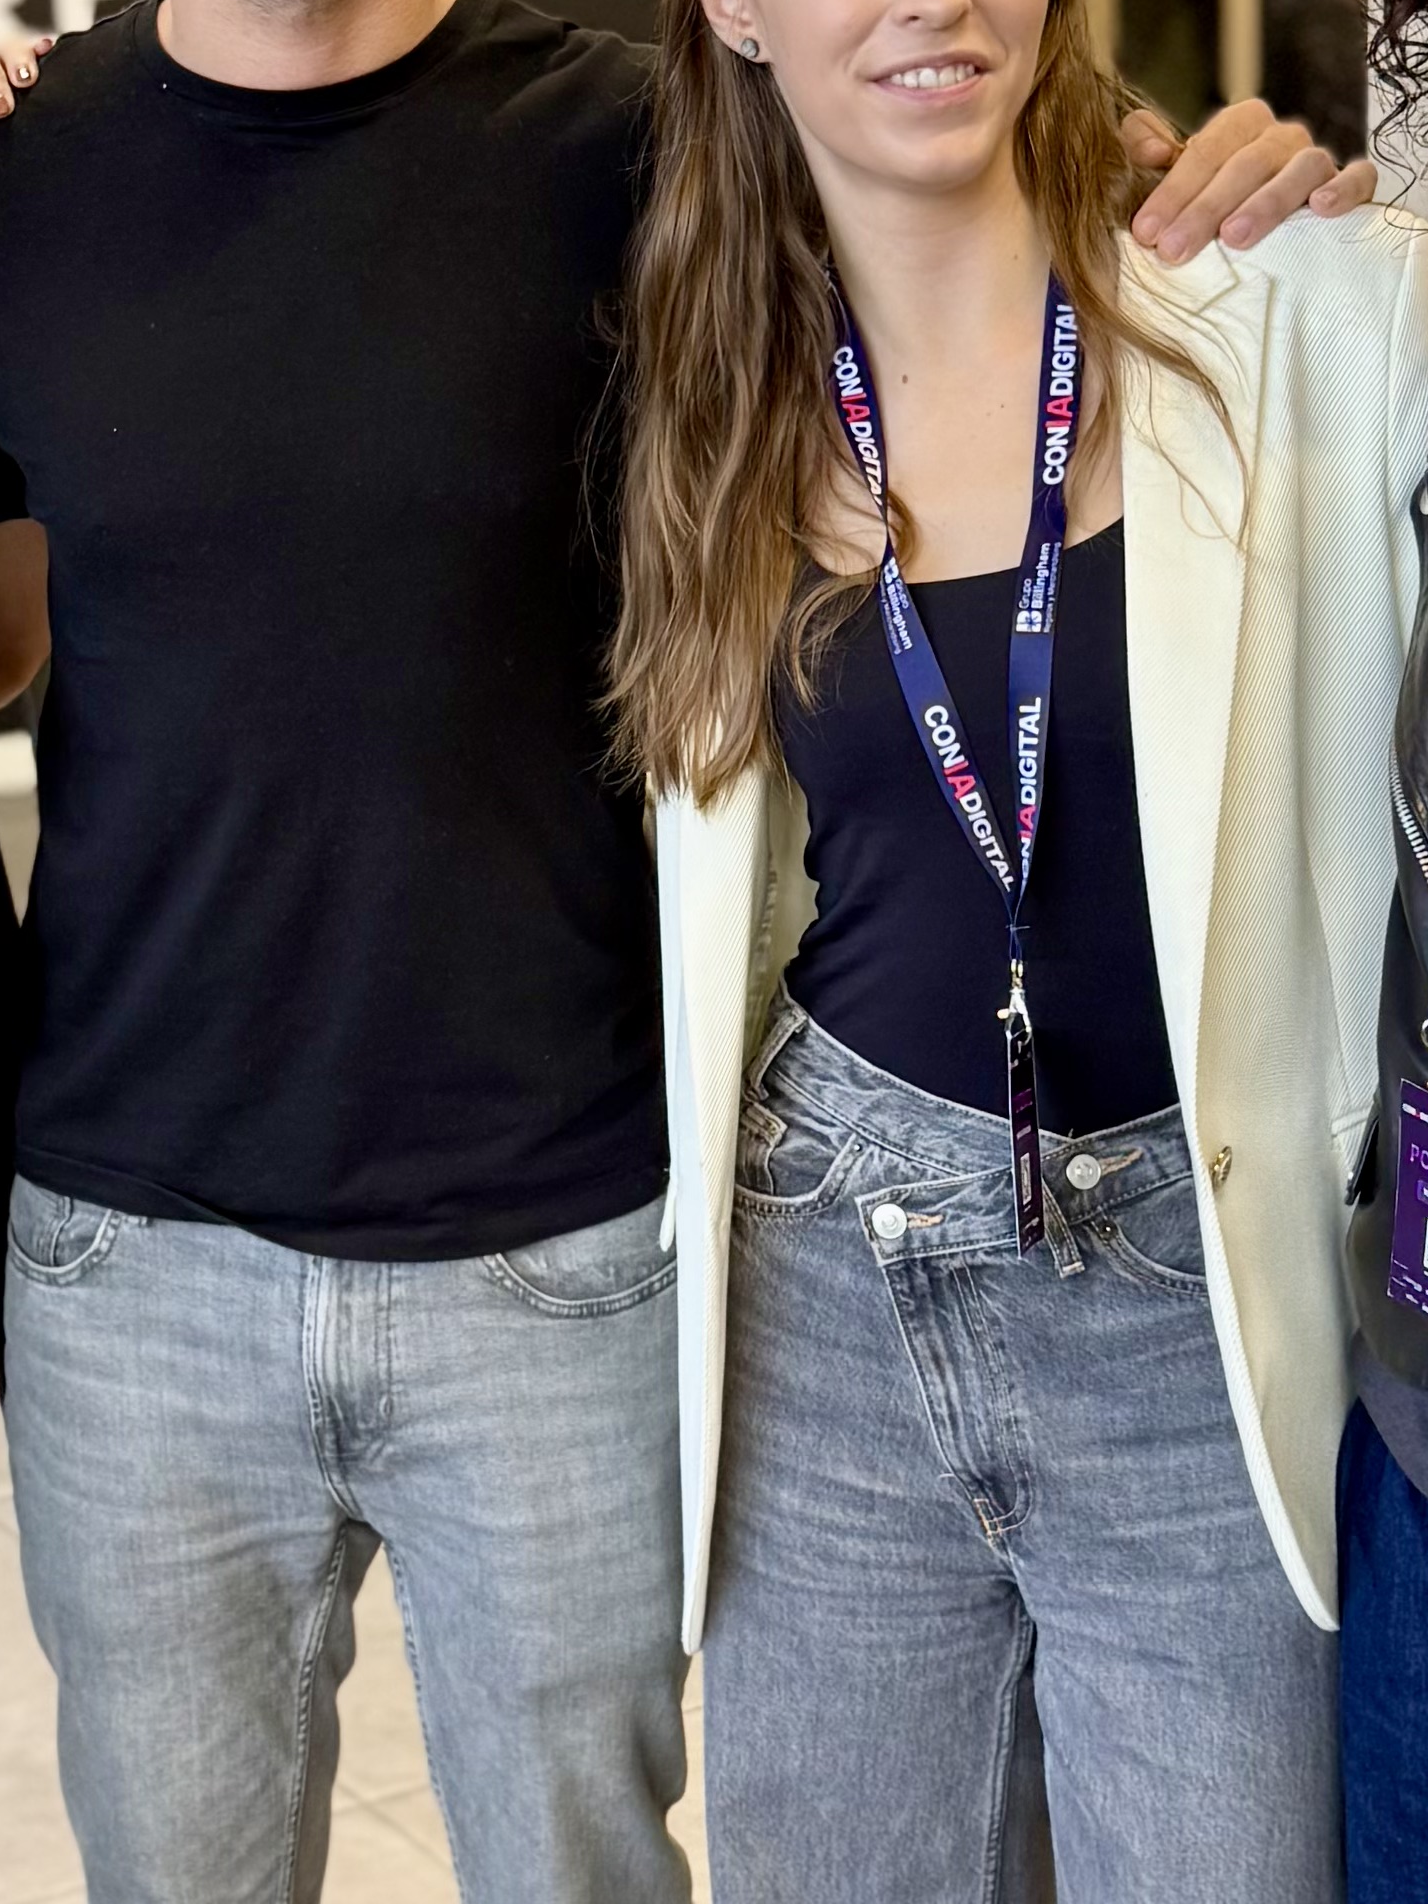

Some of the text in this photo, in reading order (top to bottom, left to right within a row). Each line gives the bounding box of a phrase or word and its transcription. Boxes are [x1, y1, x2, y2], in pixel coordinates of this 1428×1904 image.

[833, 346, 883, 506] CONIADIGITA
[1031, 542, 1051, 610] Billingham
[924, 704, 1017, 893] CONIADIGITAL
